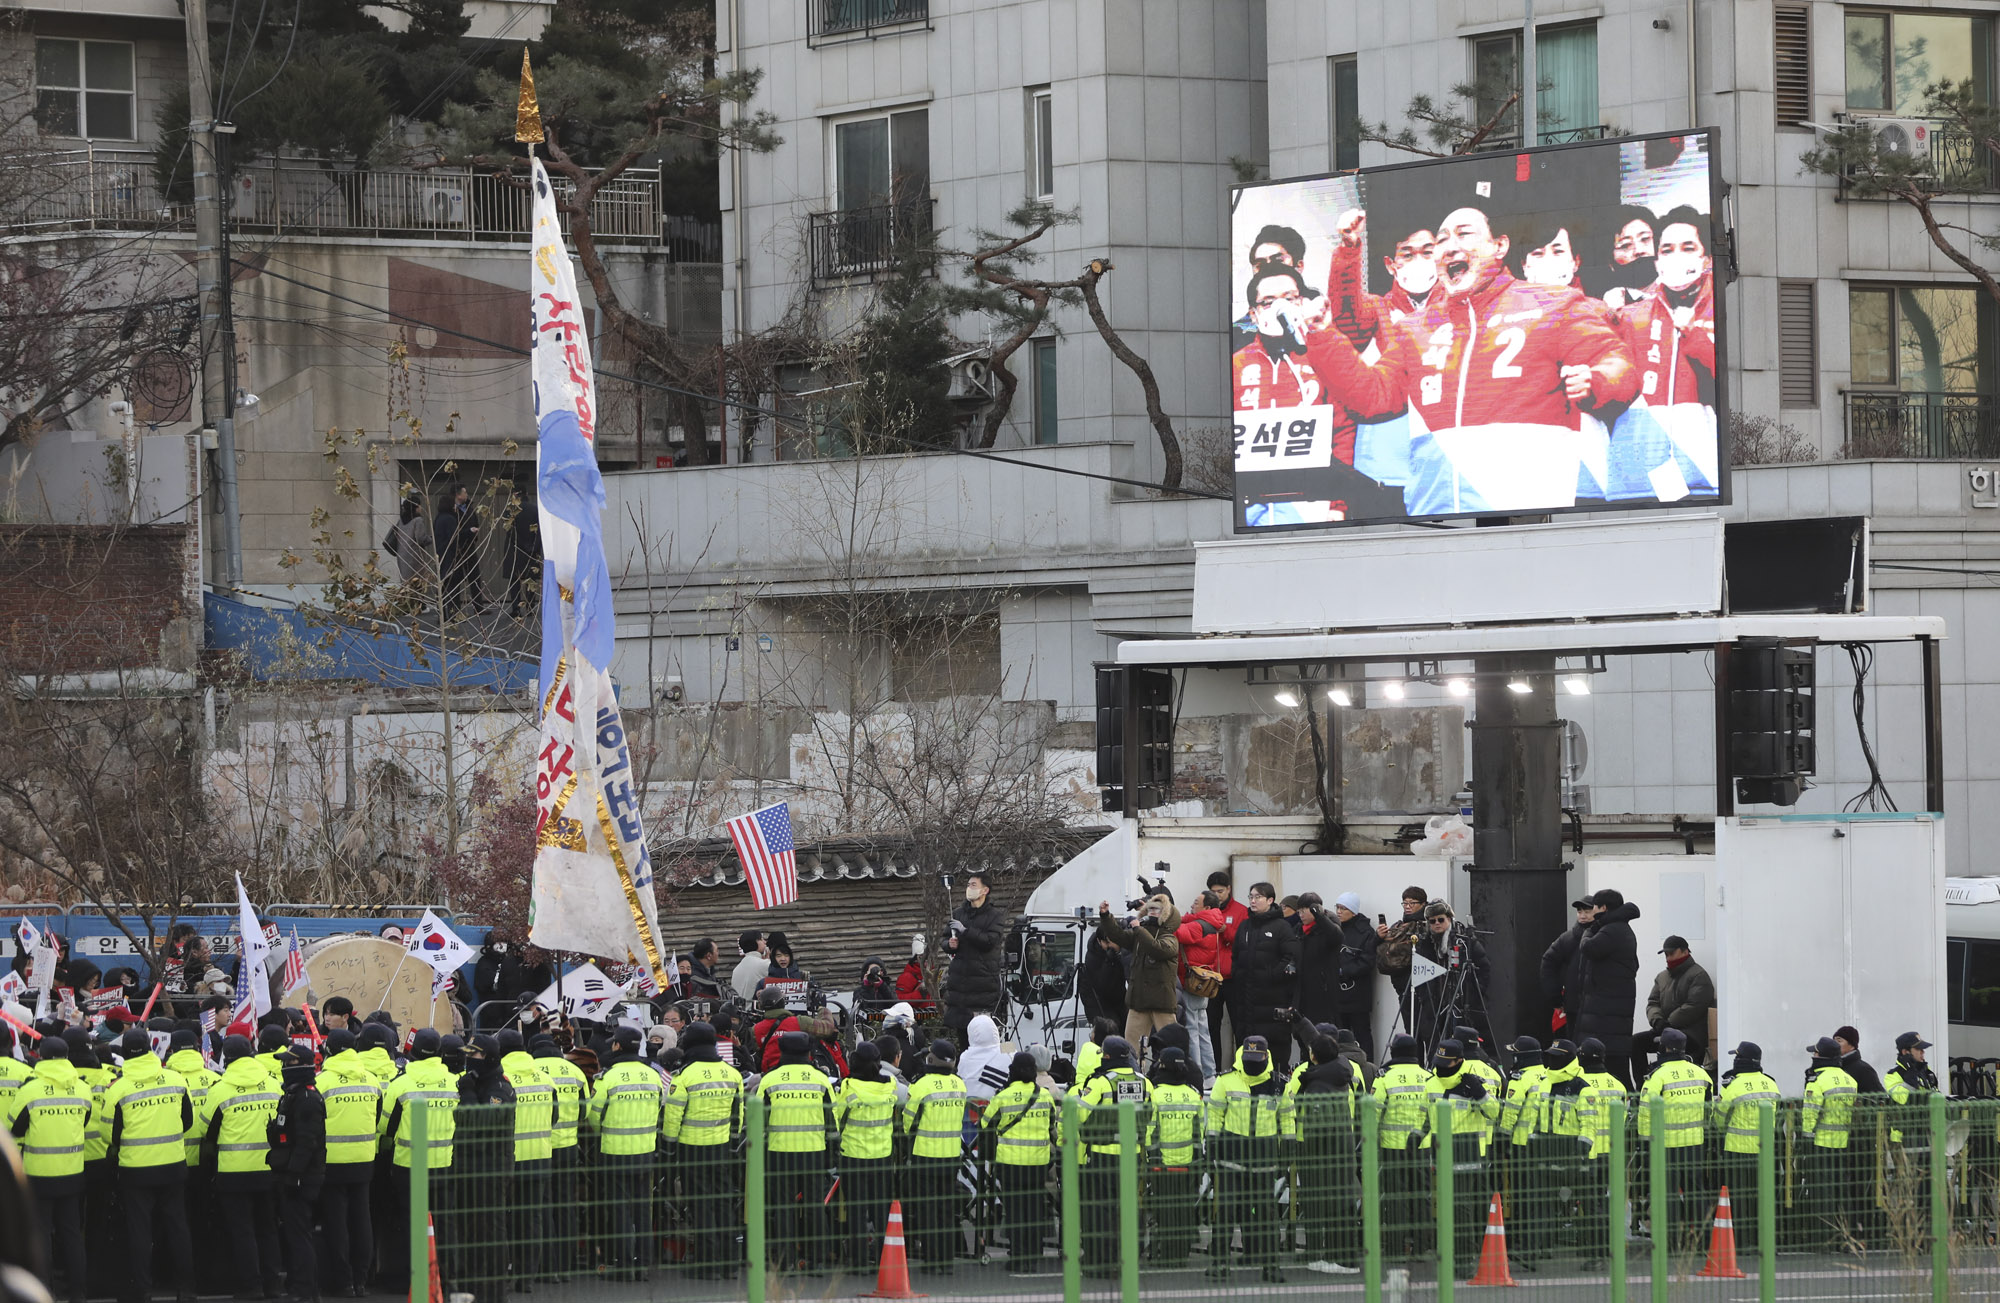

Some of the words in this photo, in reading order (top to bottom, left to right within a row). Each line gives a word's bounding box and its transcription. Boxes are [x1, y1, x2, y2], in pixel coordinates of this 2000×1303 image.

[1491, 327, 1526, 379] 2
[620, 1071, 649, 1081] 경찰
[702, 1069, 729, 1079] 경찰
[781, 1071, 811, 1081] 경찰
[1397, 1074, 1424, 1083] 경찰
[1671, 1070, 1696, 1079] 경찰
[934, 1079, 959, 1089] 경찰
[1744, 1081, 1769, 1091] 경찰
[617, 1092, 656, 1101] POLICE
[1164, 1092, 1190, 1102] 경찰
[1670, 1088, 1703, 1097] POLICE
[132, 1096, 177, 1109] POLICE
[335, 1095, 376, 1103] POLICE
[427, 1100, 454, 1108] LICE
[40, 1107, 84, 1116] POLICE
[233, 1102, 276, 1113] POLICE
